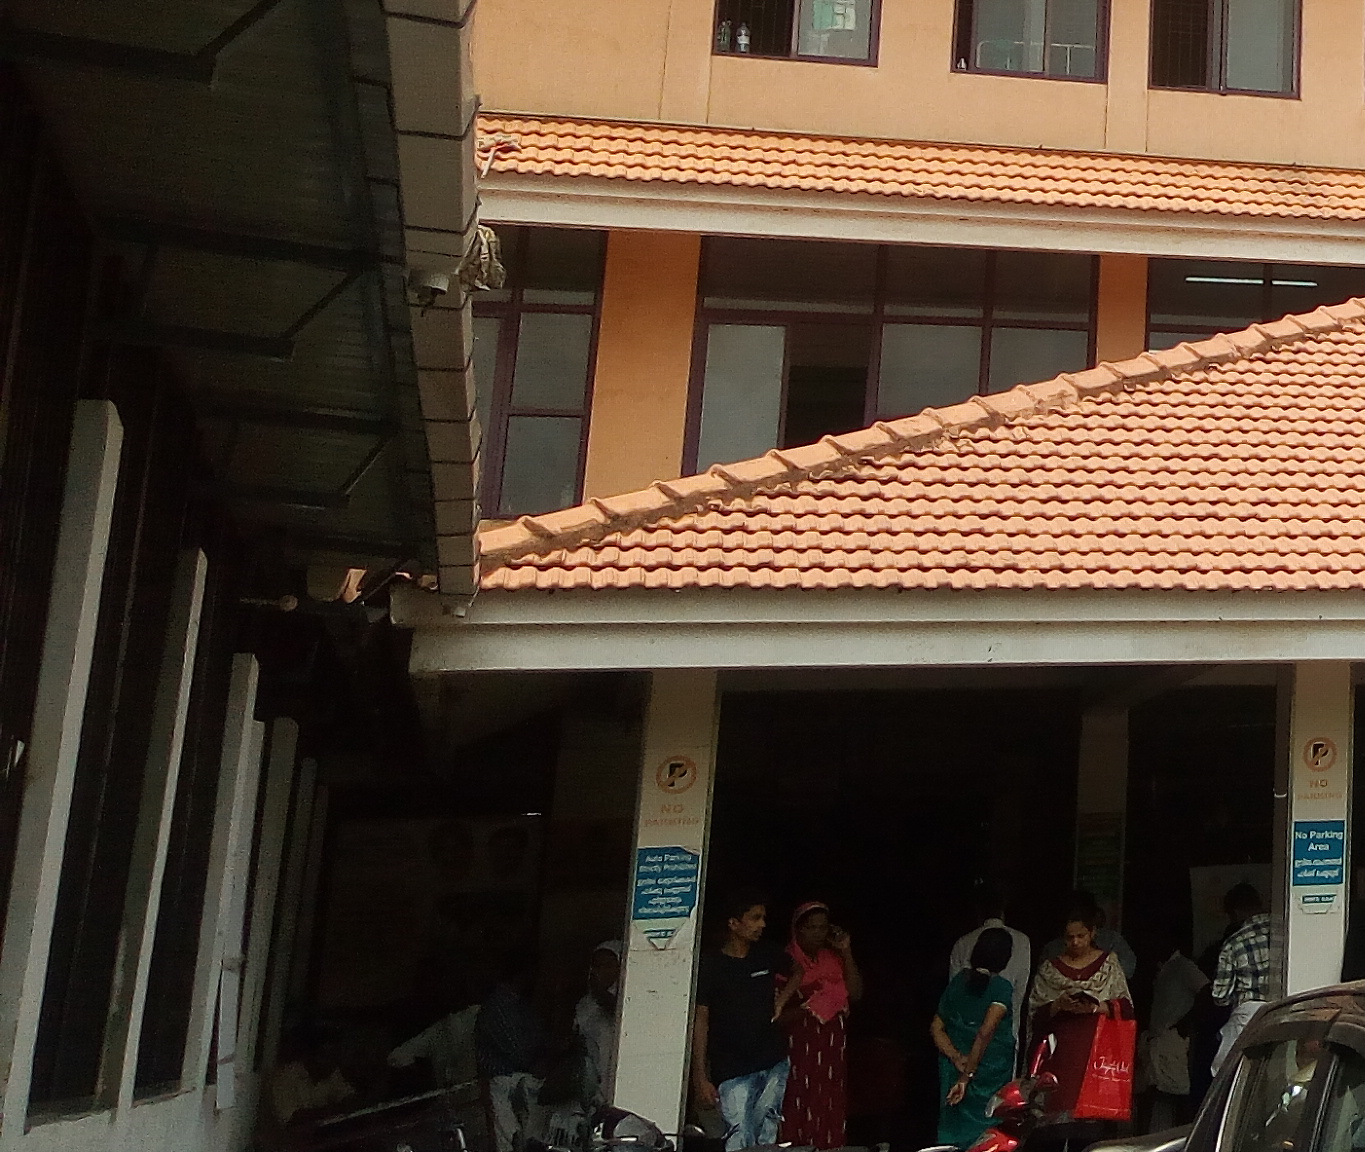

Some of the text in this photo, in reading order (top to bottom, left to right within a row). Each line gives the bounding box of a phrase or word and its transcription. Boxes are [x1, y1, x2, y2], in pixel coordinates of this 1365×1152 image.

[1295, 830, 1343, 840] No Parking
[1308, 842, 1330, 851] Area
